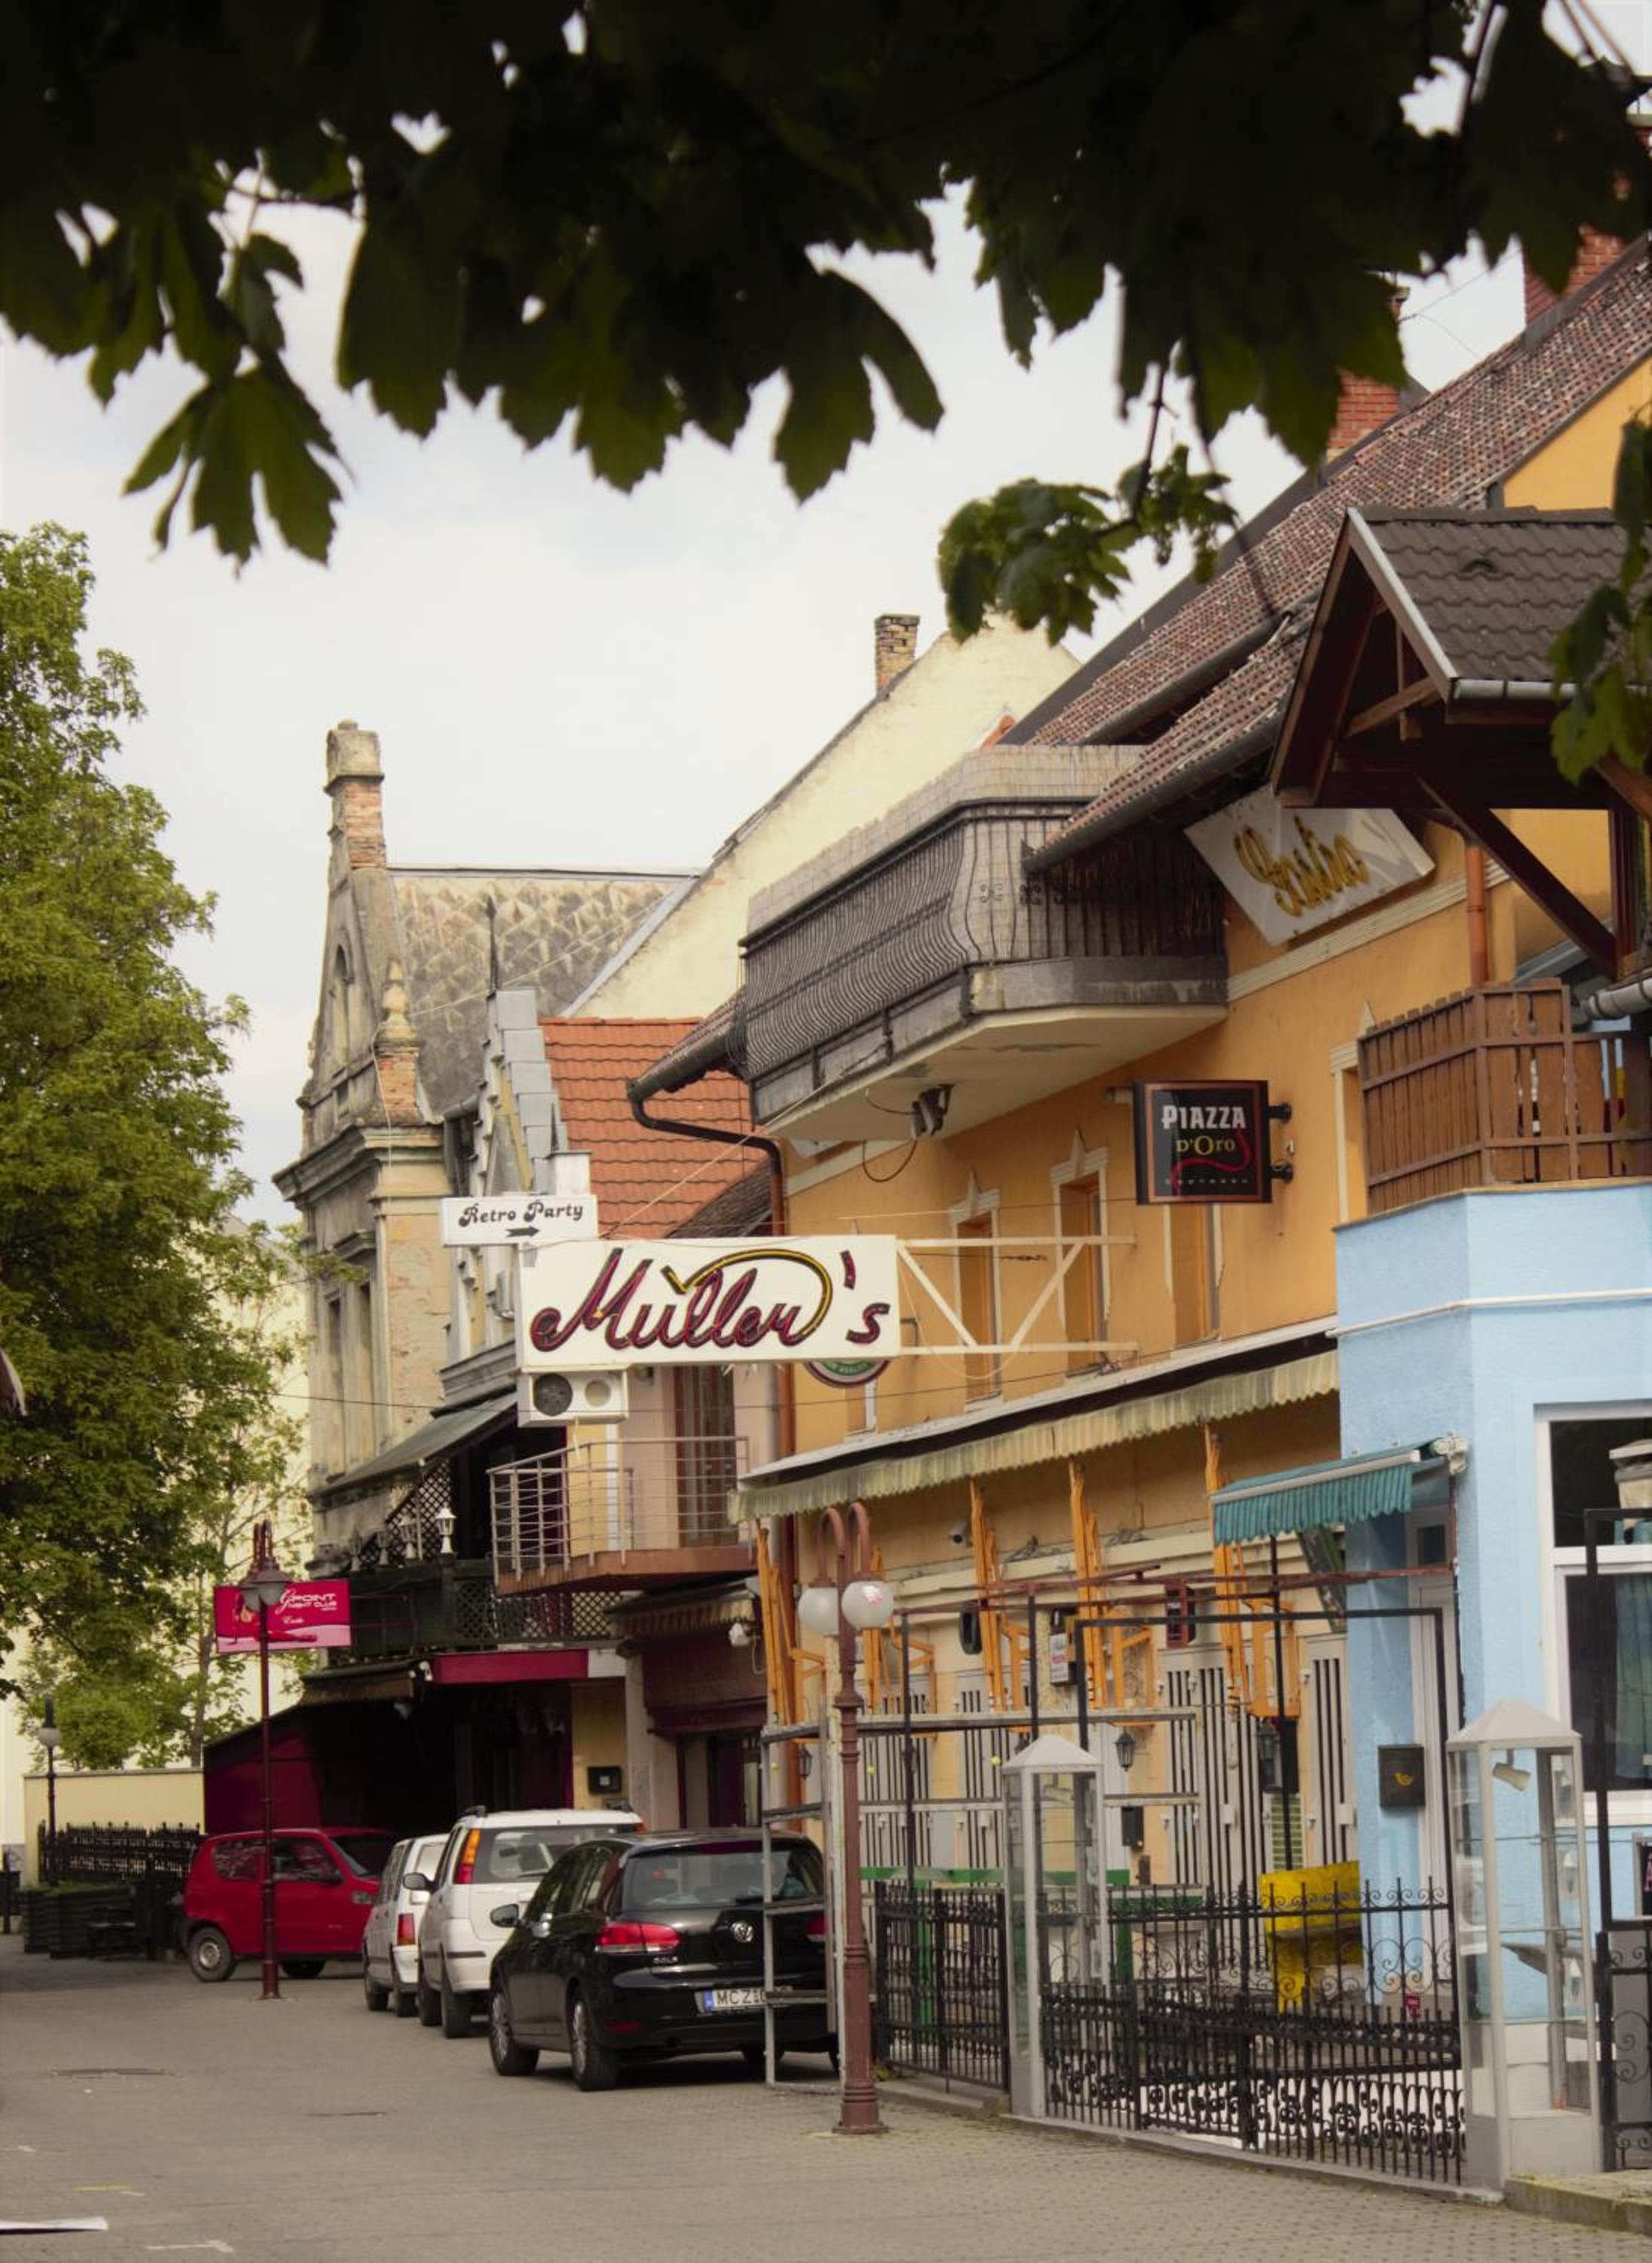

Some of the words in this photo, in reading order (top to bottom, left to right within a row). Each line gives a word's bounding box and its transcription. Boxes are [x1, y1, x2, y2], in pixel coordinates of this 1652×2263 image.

[1161, 1104, 1246, 1129] PIAZZA
[459, 1202, 517, 1227] Retro
[524, 1200, 583, 1222] Party
